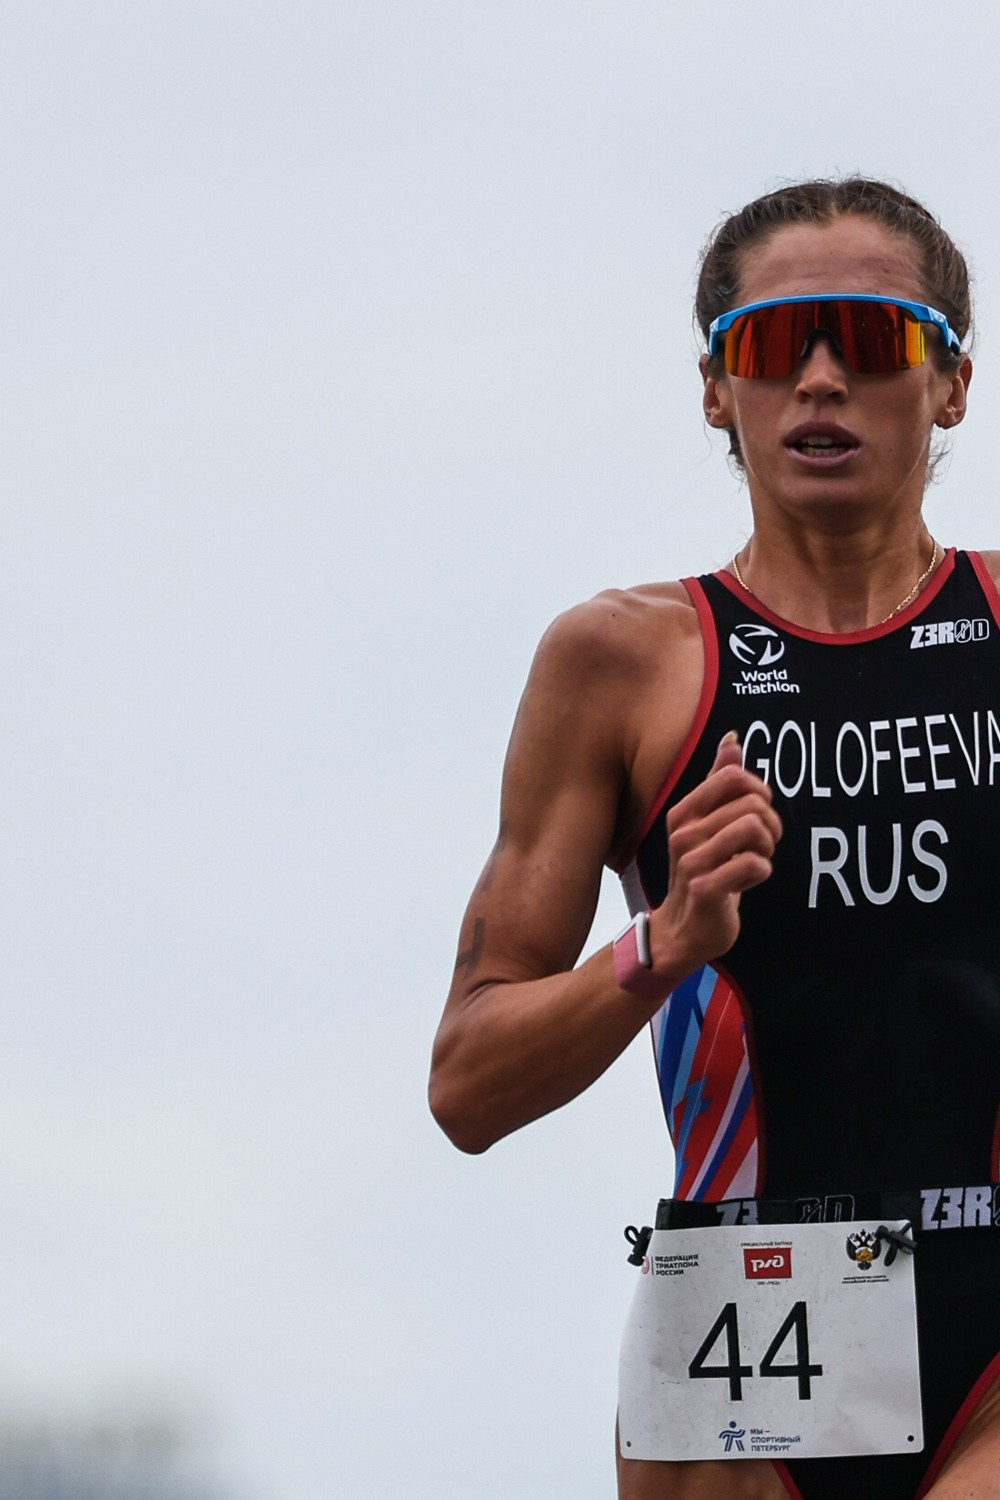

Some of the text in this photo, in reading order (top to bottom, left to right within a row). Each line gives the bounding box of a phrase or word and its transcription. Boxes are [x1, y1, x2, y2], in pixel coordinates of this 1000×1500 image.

[741, 669, 788, 683] World
[732, 681, 800, 695] Triathlon
[808, 819, 949, 909] RUS
[655, 1254, 699, 1263] ФЕДЕРАЦИЯ
[655, 1261, 699, 1270] ТРИАТЛОНА
[688, 1300, 823, 1402] 44
[750, 1435, 801, 1444] СПОРТИВНЫЙ
